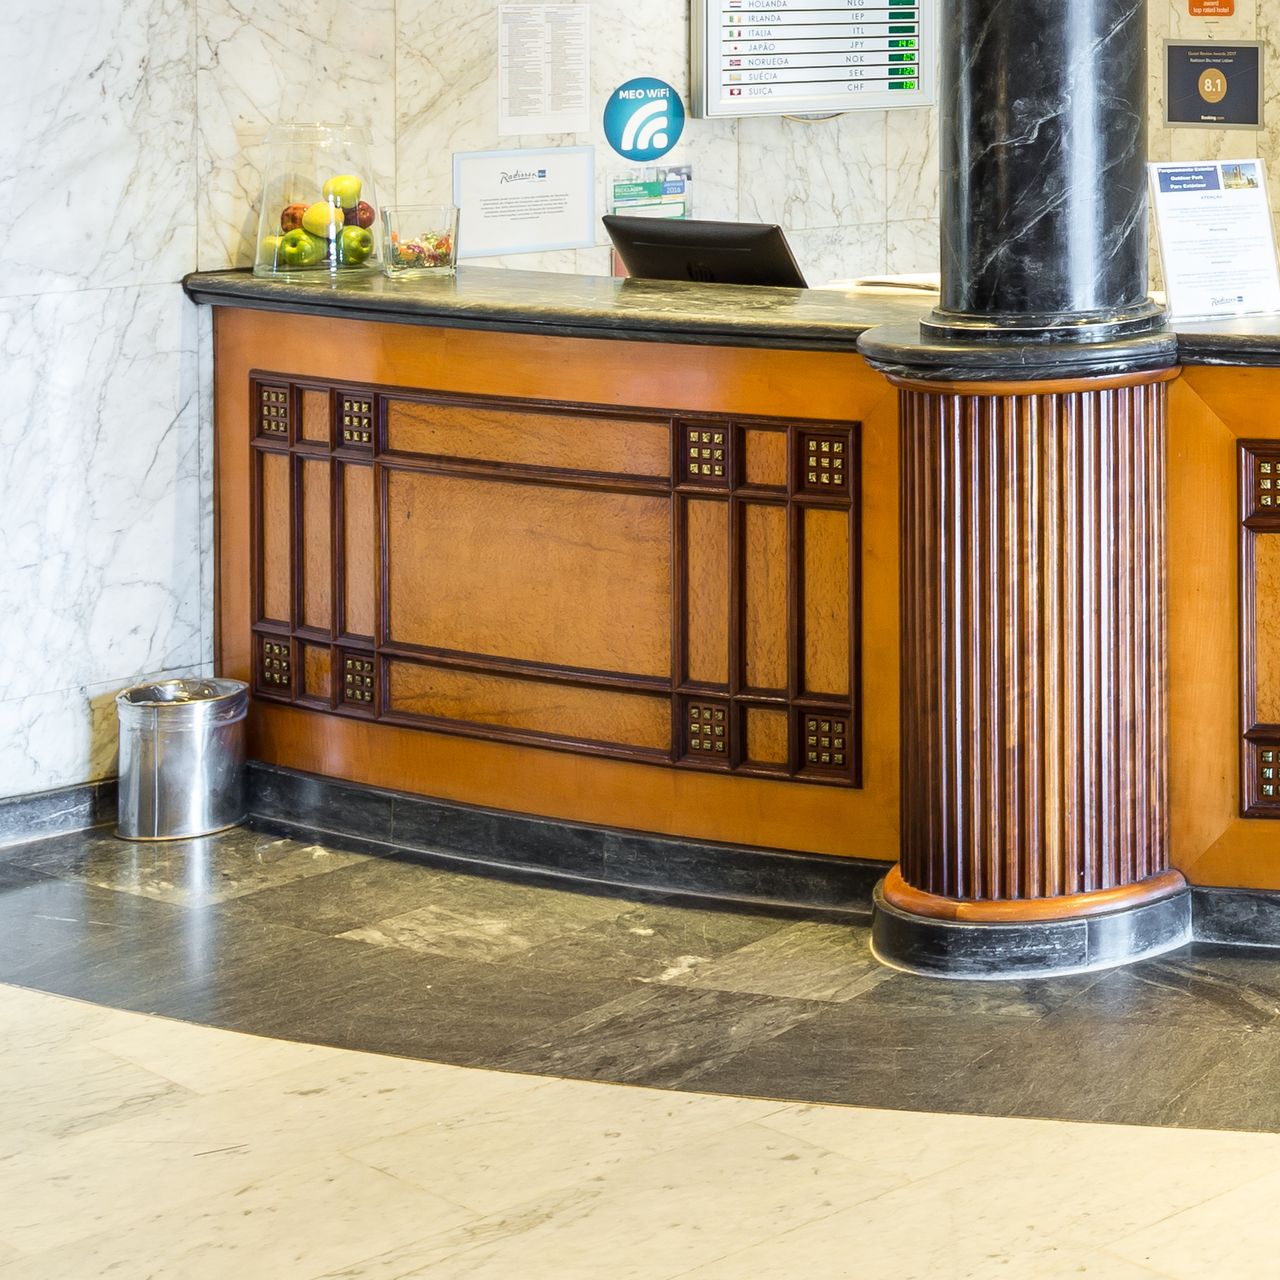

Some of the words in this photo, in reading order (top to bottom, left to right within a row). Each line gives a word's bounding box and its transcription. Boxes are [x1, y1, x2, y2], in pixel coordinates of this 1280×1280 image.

[748, 0, 788, 8] HOLANDA
[748, 14, 782, 23] IRLANDA
[850, 40, 865, 49] JPY
[748, 57, 789, 66] NORUEGA
[845, 55, 865, 63] NOK
[849, 69, 865, 77] SEK
[847, 83, 865, 91] CHF
[1204, 78, 1221, 92] 8.1
[619, 89, 645, 100] MEO
[646, 88, 670, 98] WiFi
[500, 170, 537, 184] Radisson
